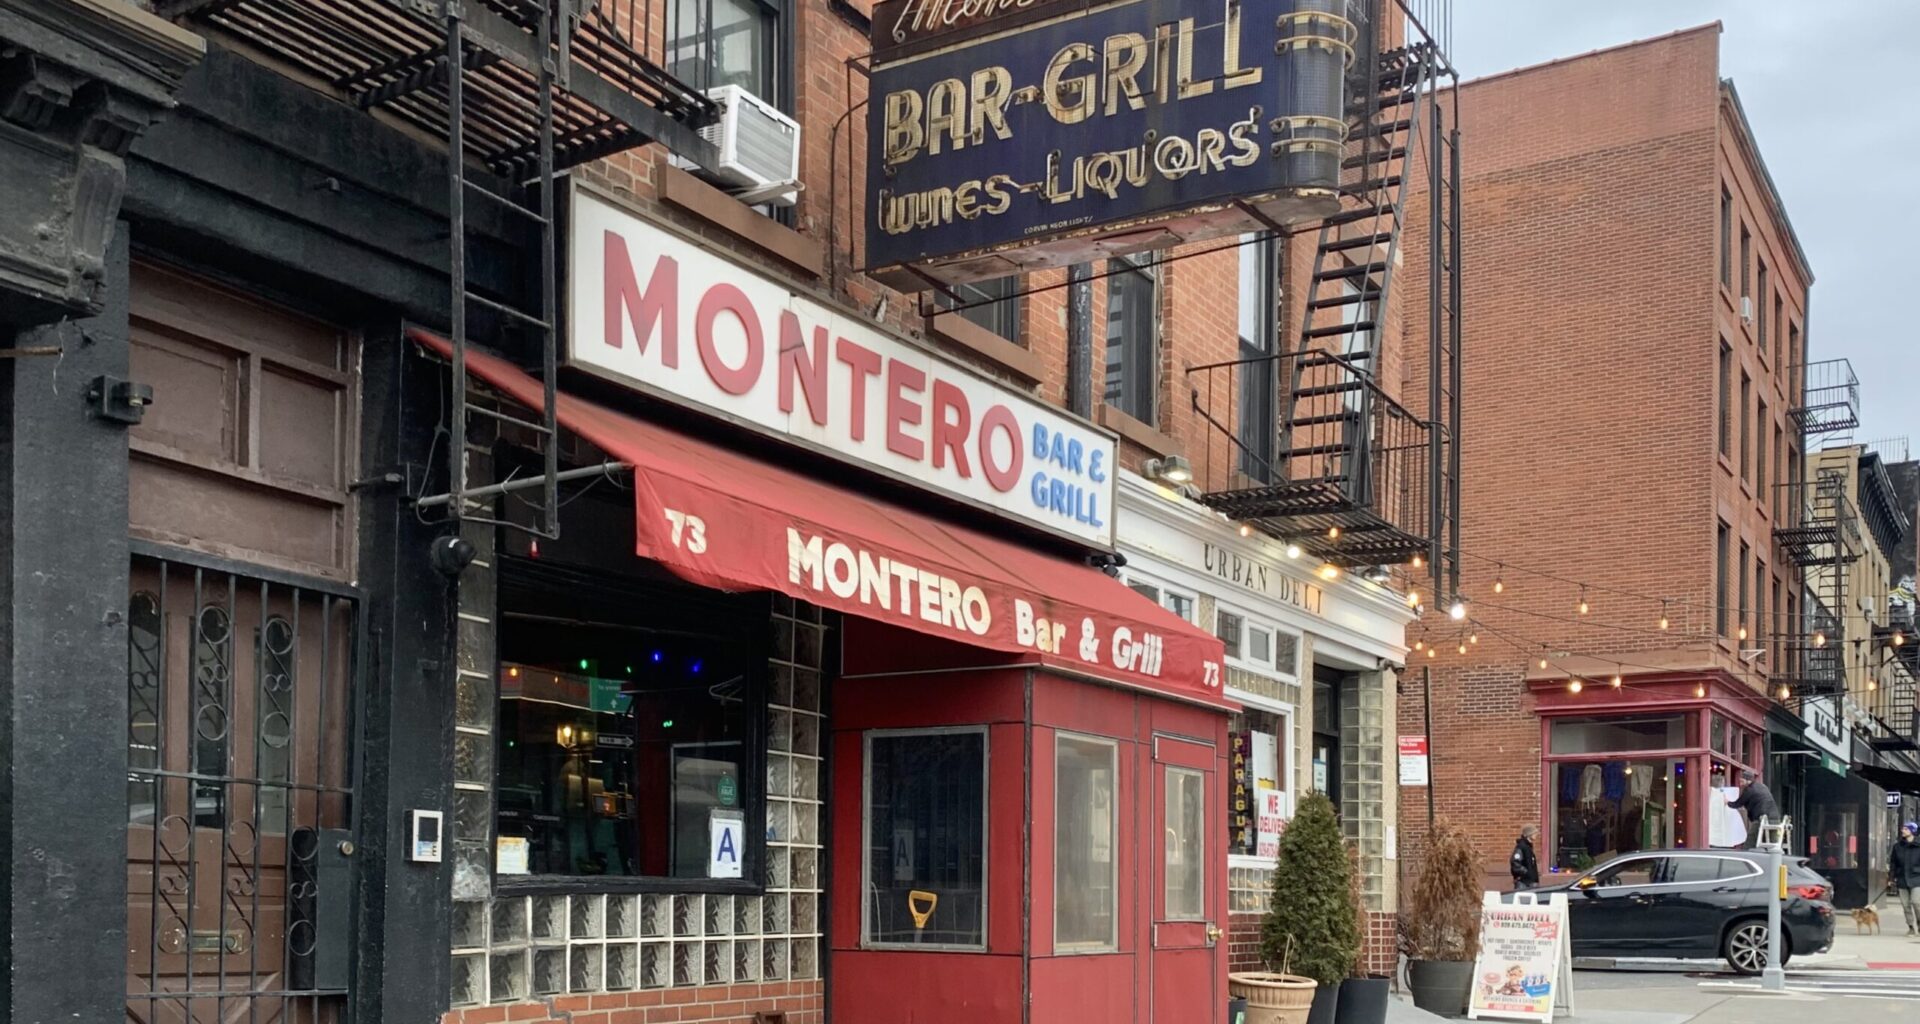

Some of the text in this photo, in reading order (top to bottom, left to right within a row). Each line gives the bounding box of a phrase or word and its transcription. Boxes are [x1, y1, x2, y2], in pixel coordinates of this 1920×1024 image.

[603, 228, 1024, 493] MONTERO
[1033, 421, 1105, 483] BAR &
[1031, 471, 1103, 528] GRILL
[664, 507, 708, 555] 73
[786, 526, 1163, 678] MONTERO Bar & Grill
[1203, 542, 1322, 615] URBAN DELI
[1203, 660, 1219, 688] 73
[1267, 793, 1279, 815] WE
[717, 827, 737, 863] A
[1491, 912, 1523, 921] URBAN
